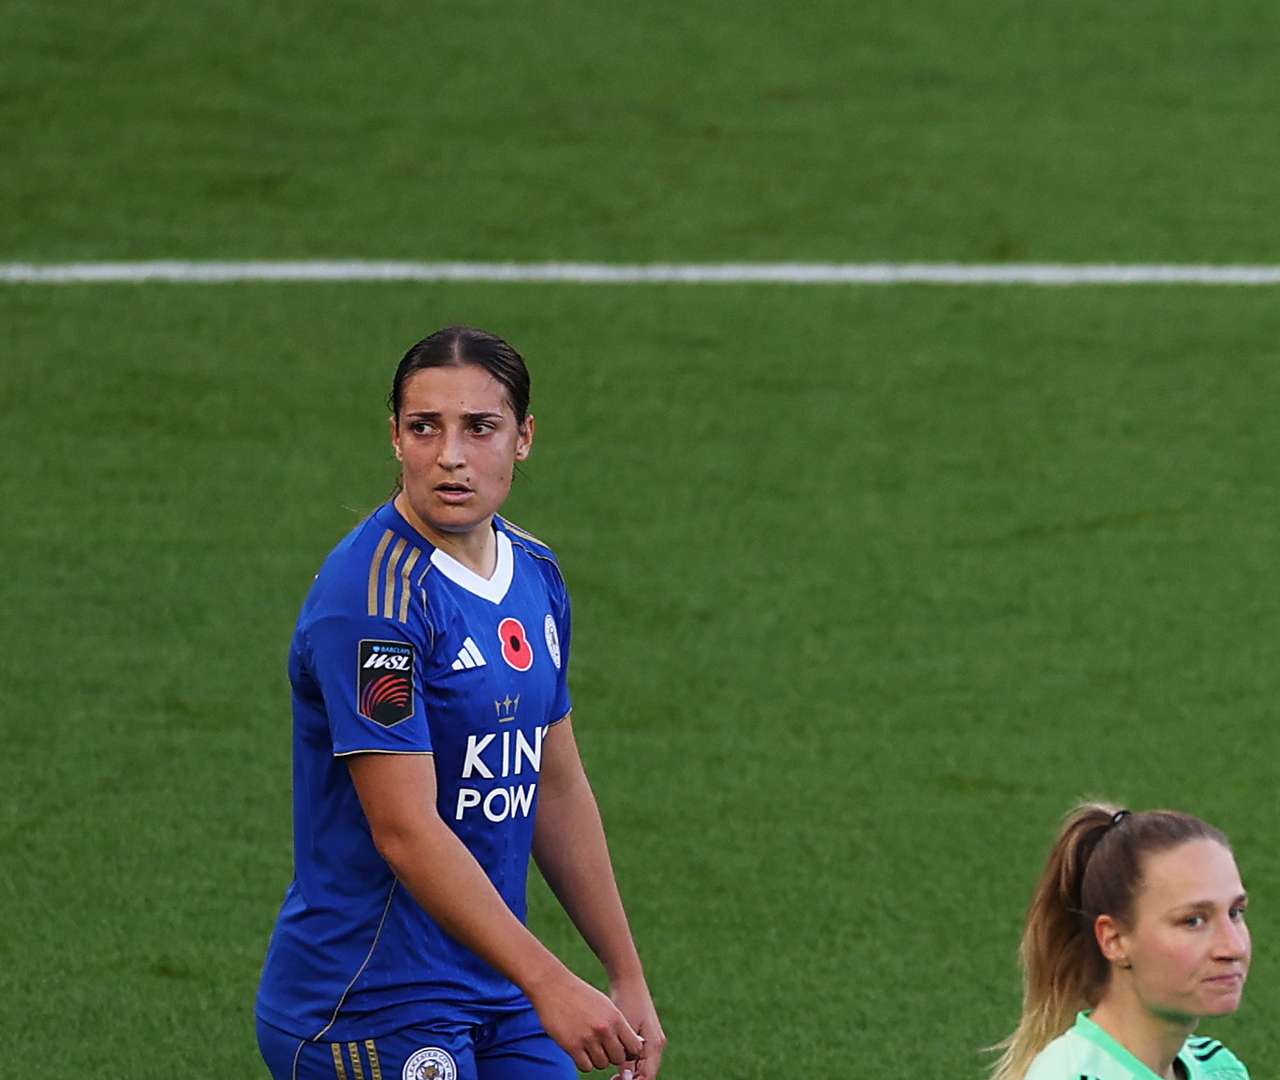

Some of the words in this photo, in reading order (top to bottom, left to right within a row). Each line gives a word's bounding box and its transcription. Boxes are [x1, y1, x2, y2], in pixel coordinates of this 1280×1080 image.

[362, 653, 411, 671] WSL
[461, 725, 549, 779] KIN
[455, 783, 537, 823] POW
